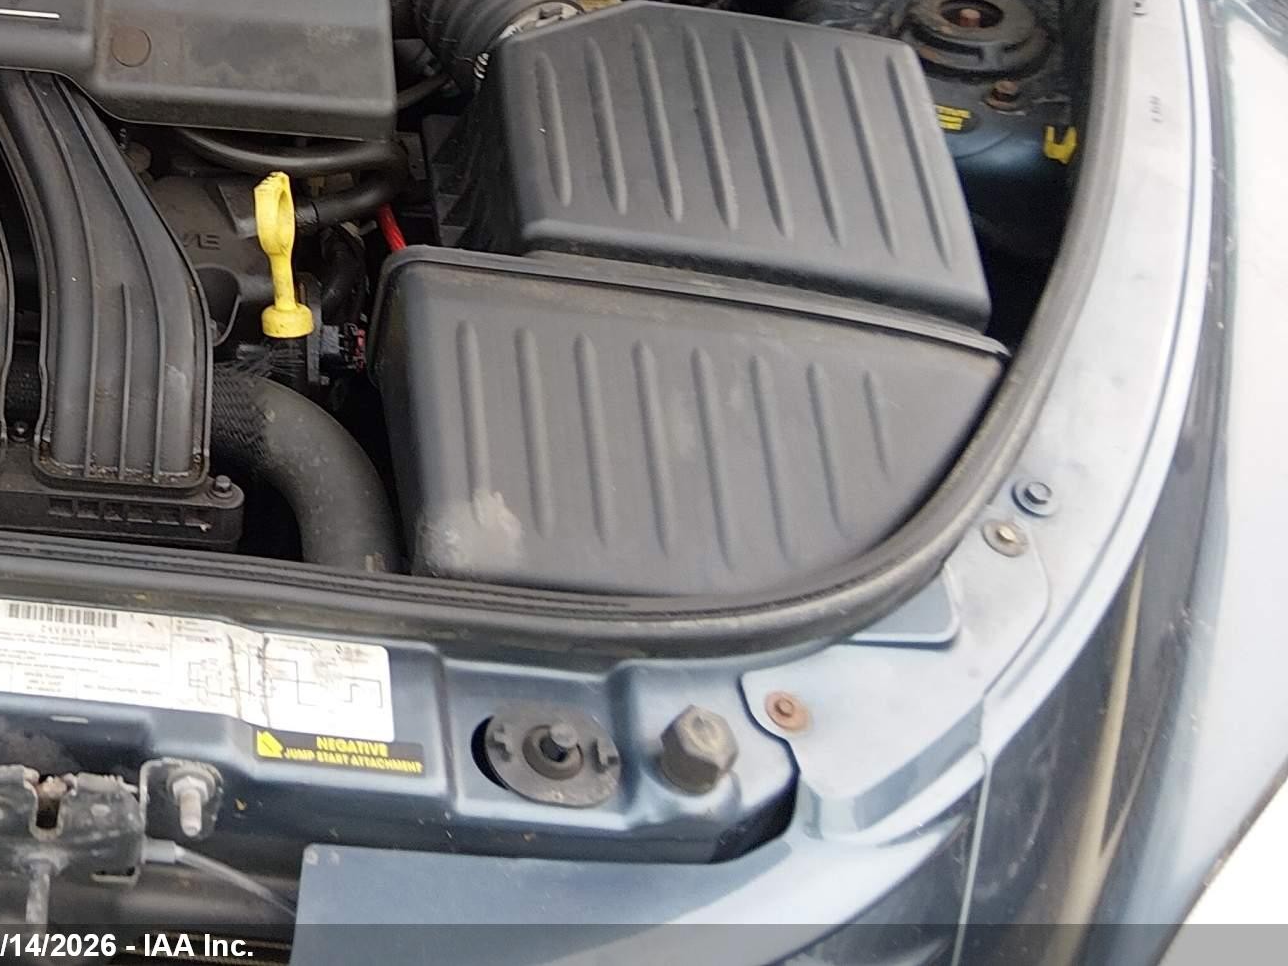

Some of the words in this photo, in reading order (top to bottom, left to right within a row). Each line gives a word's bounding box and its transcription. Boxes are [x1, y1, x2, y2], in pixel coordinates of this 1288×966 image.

[316, 736, 389, 757] NEGATIVE
[284, 747, 315, 761] JUMP
[316, 750, 351, 765] START
[350, 754, 424, 773] ATTACHMENT
